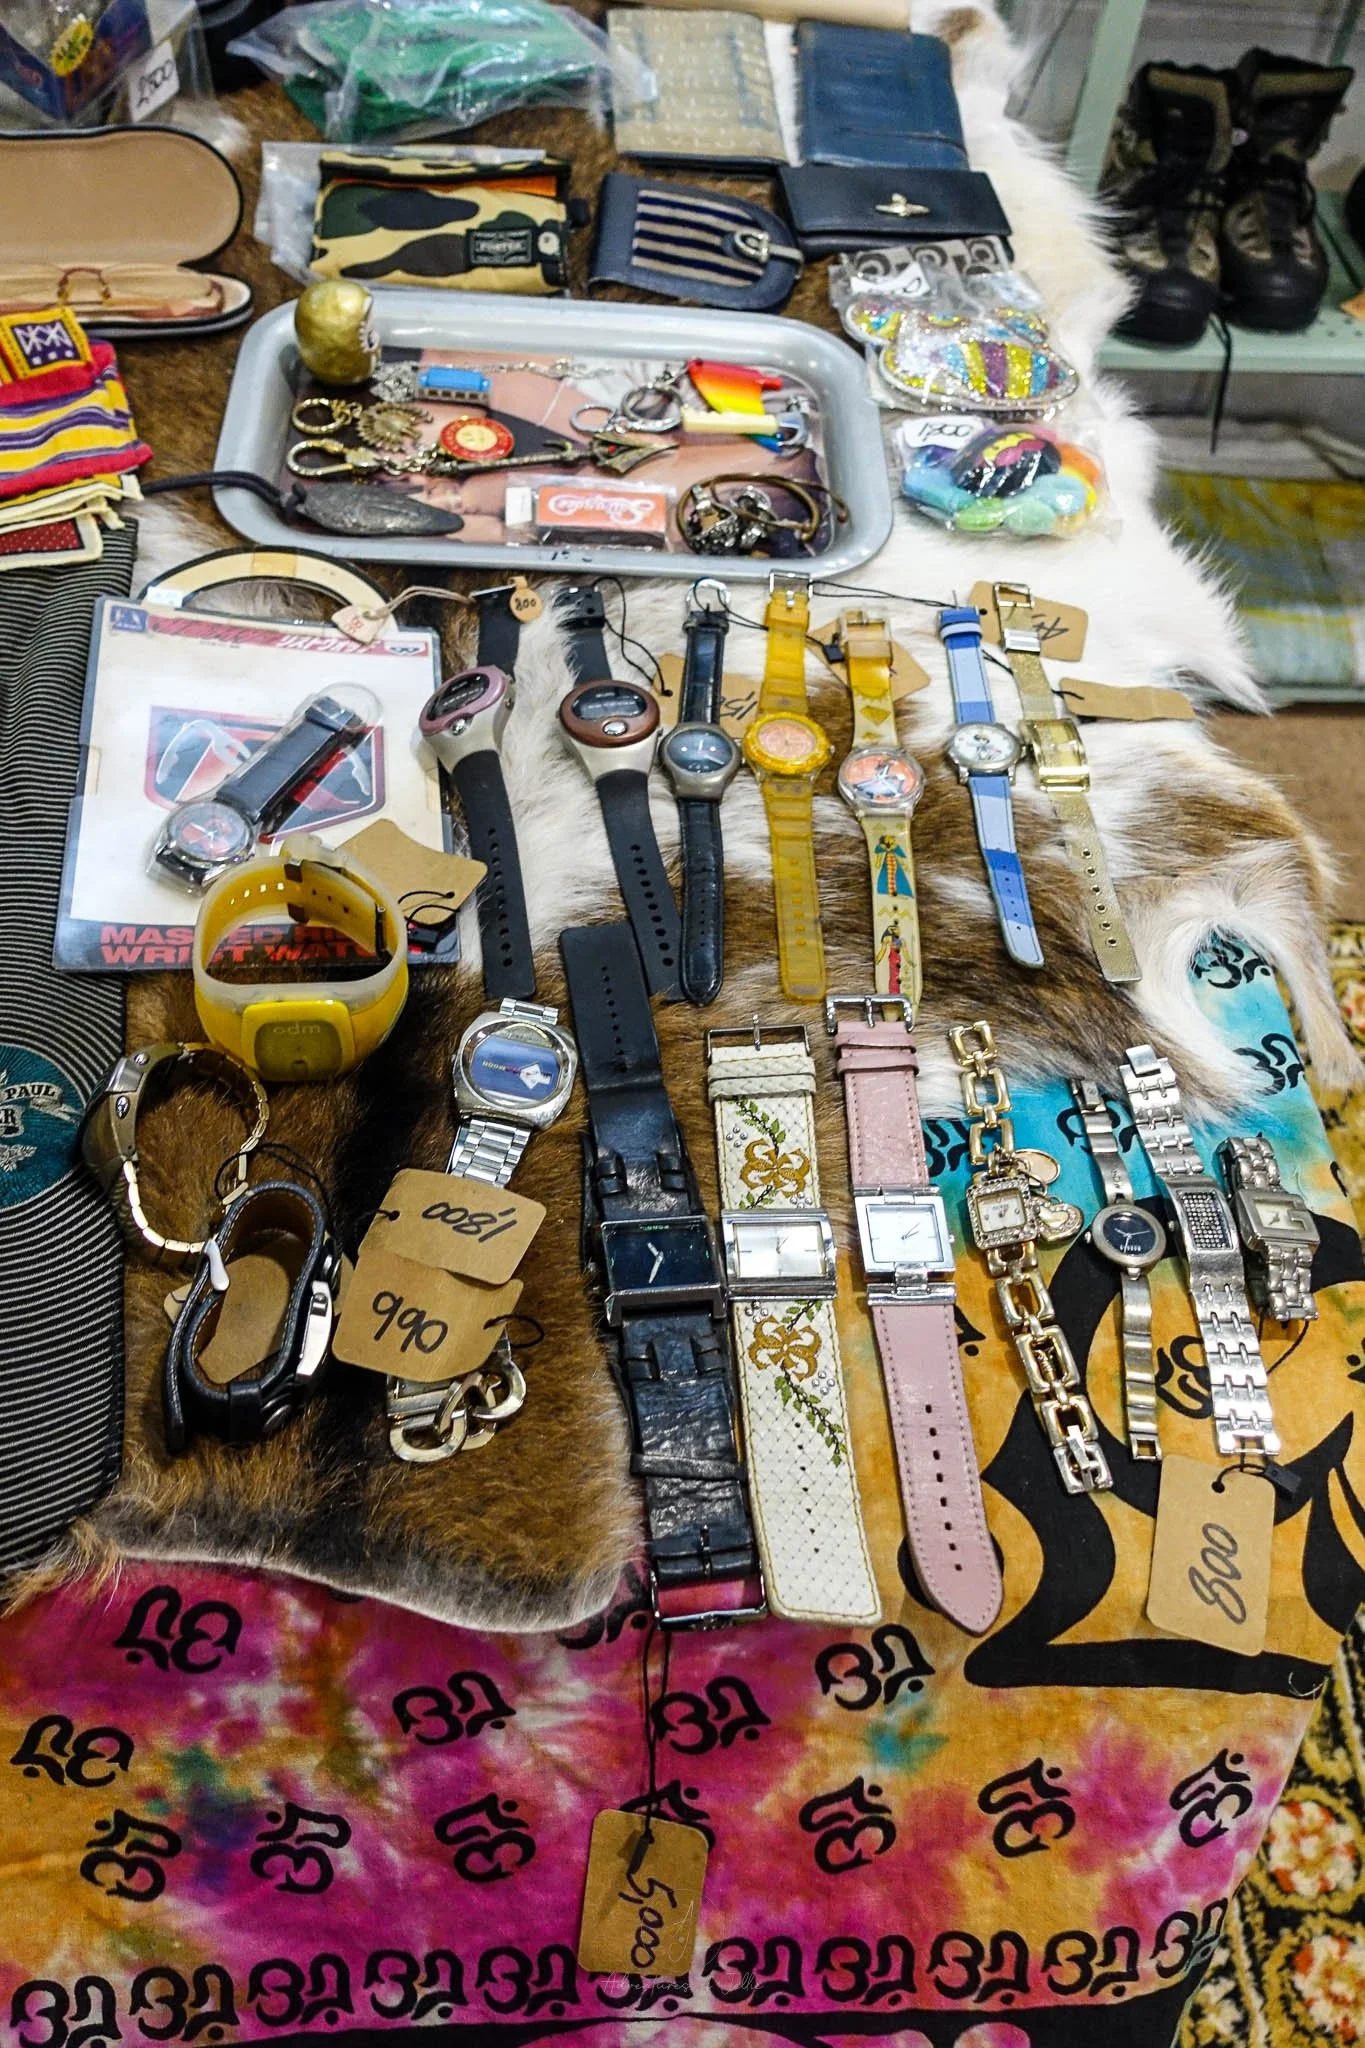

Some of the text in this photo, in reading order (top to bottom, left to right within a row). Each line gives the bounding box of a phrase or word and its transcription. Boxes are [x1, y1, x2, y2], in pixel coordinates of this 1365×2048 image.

[100, 925, 284, 946] MASED
[4, 1084, 57, 1101] PAUL
[421, 1201, 518, 1244] 1,800
[371, 1290, 449, 1354] 990
[1187, 1522, 1247, 1625] 800
